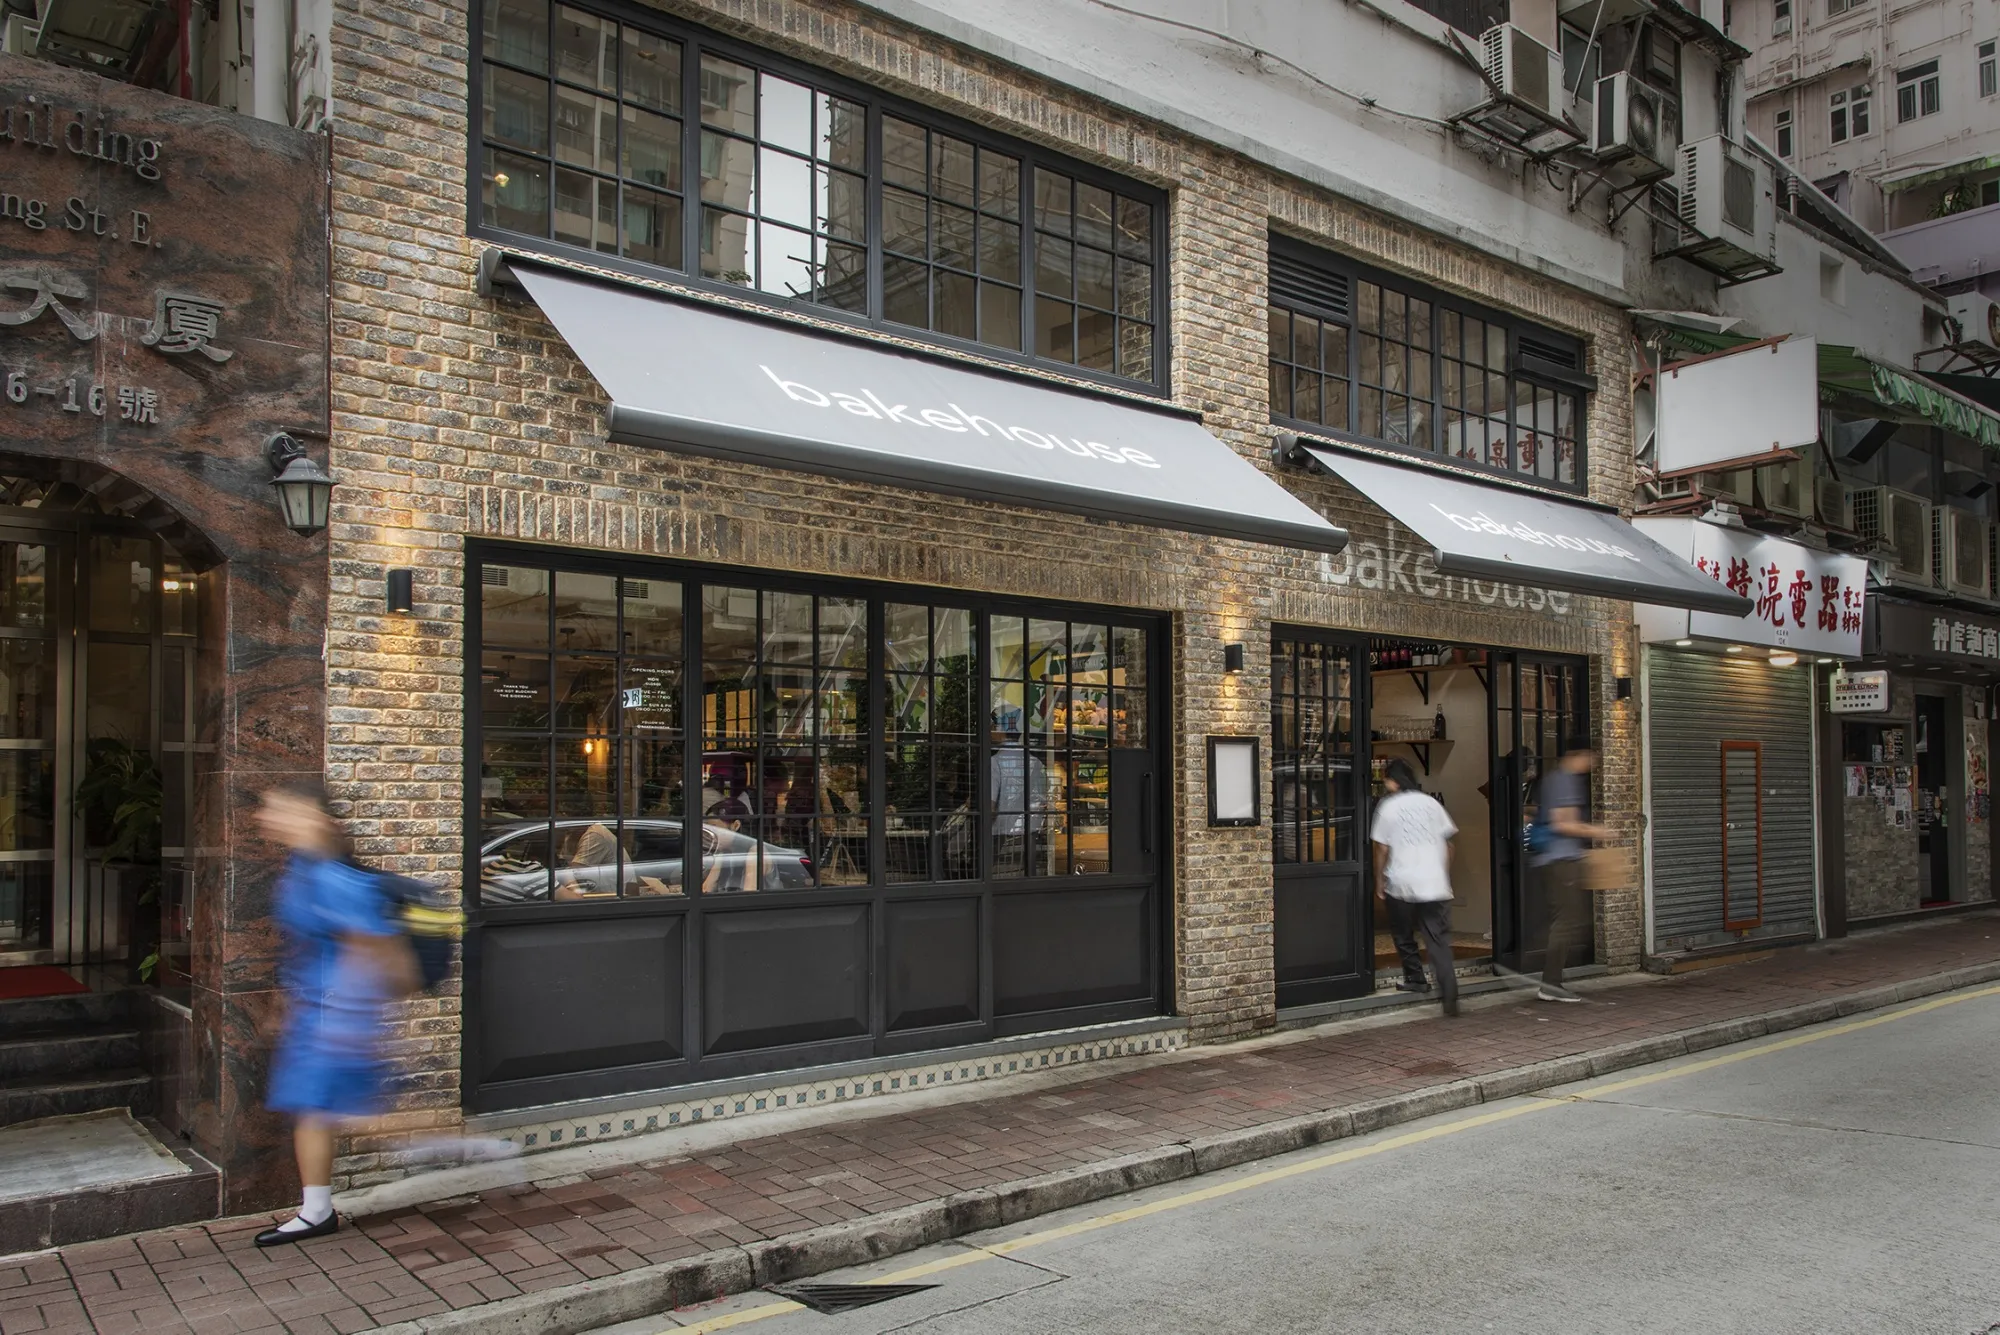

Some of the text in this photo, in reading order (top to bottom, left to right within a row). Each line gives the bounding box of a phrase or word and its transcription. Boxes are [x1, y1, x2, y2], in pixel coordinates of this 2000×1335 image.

[64, 196, 118, 239] St.
[131, 209, 162, 248] E.
[0, 267, 234, 362] 大廈
[759, 364, 1162, 469] bakehouse
[1428, 502, 1641, 563] bakehouse
